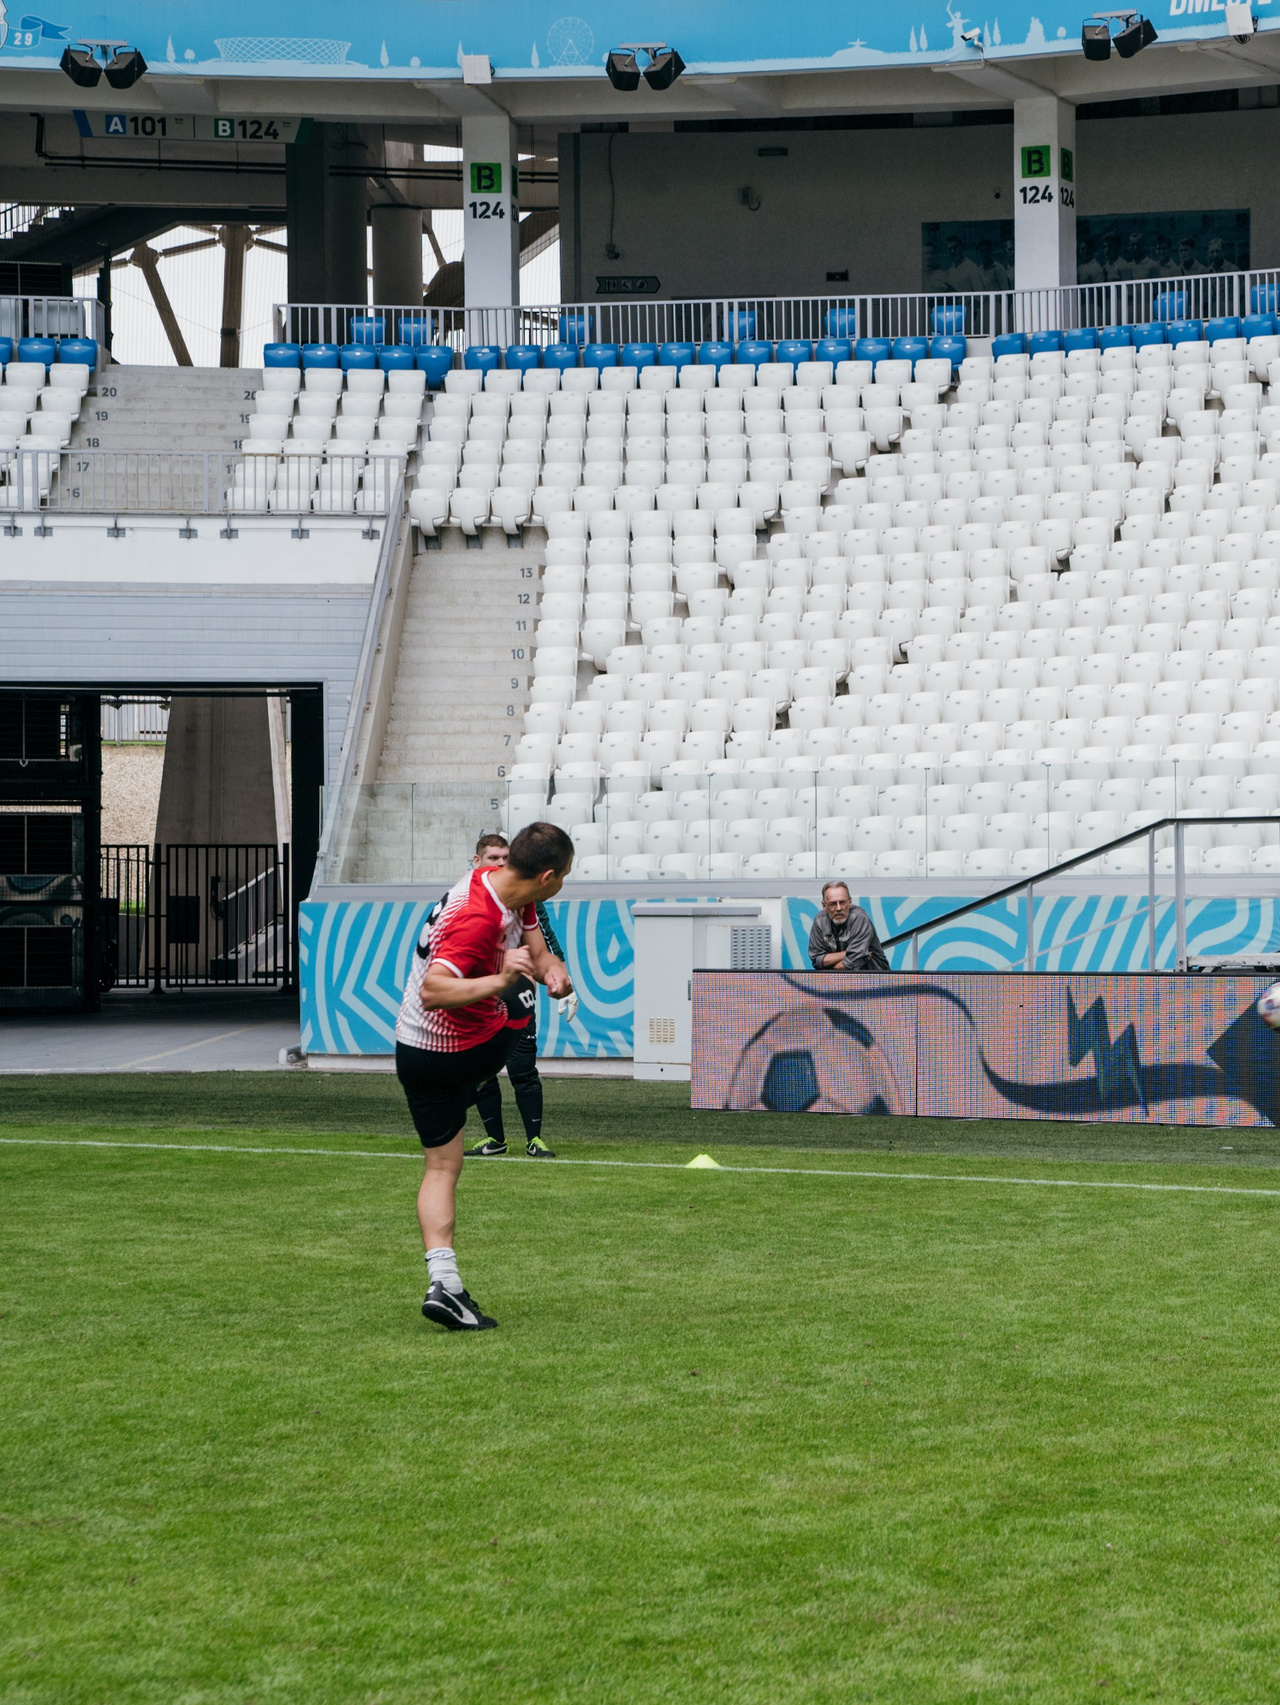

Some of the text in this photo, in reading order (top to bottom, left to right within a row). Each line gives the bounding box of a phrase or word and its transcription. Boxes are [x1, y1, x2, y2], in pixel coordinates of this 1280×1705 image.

[13, 32, 33, 46] 29
[109, 116, 167, 136] A 101
[218, 119, 279, 140] B 124
[1027, 149, 1044, 175] B
[477, 165, 495, 190] B
[1019, 185, 1053, 204] 124
[1061, 186, 1074, 209] 124
[469, 201, 505, 219] 124
[102, 387, 117, 398] 20
[95, 411, 108, 422] 19
[86, 437, 100, 448] 18
[76, 461, 90, 472] 17
[225, 464, 236, 475] 1
[520, 567, 533, 578] 13
[517, 593, 530, 605] 12
[516, 620, 527, 631] 11
[511, 648, 525, 660] 10
[510, 677, 519, 689] 9
[506, 705, 515, 716] 8
[503, 734, 511, 746] 7
[497, 765, 506, 778] 6
[490, 798, 499, 810] 5
